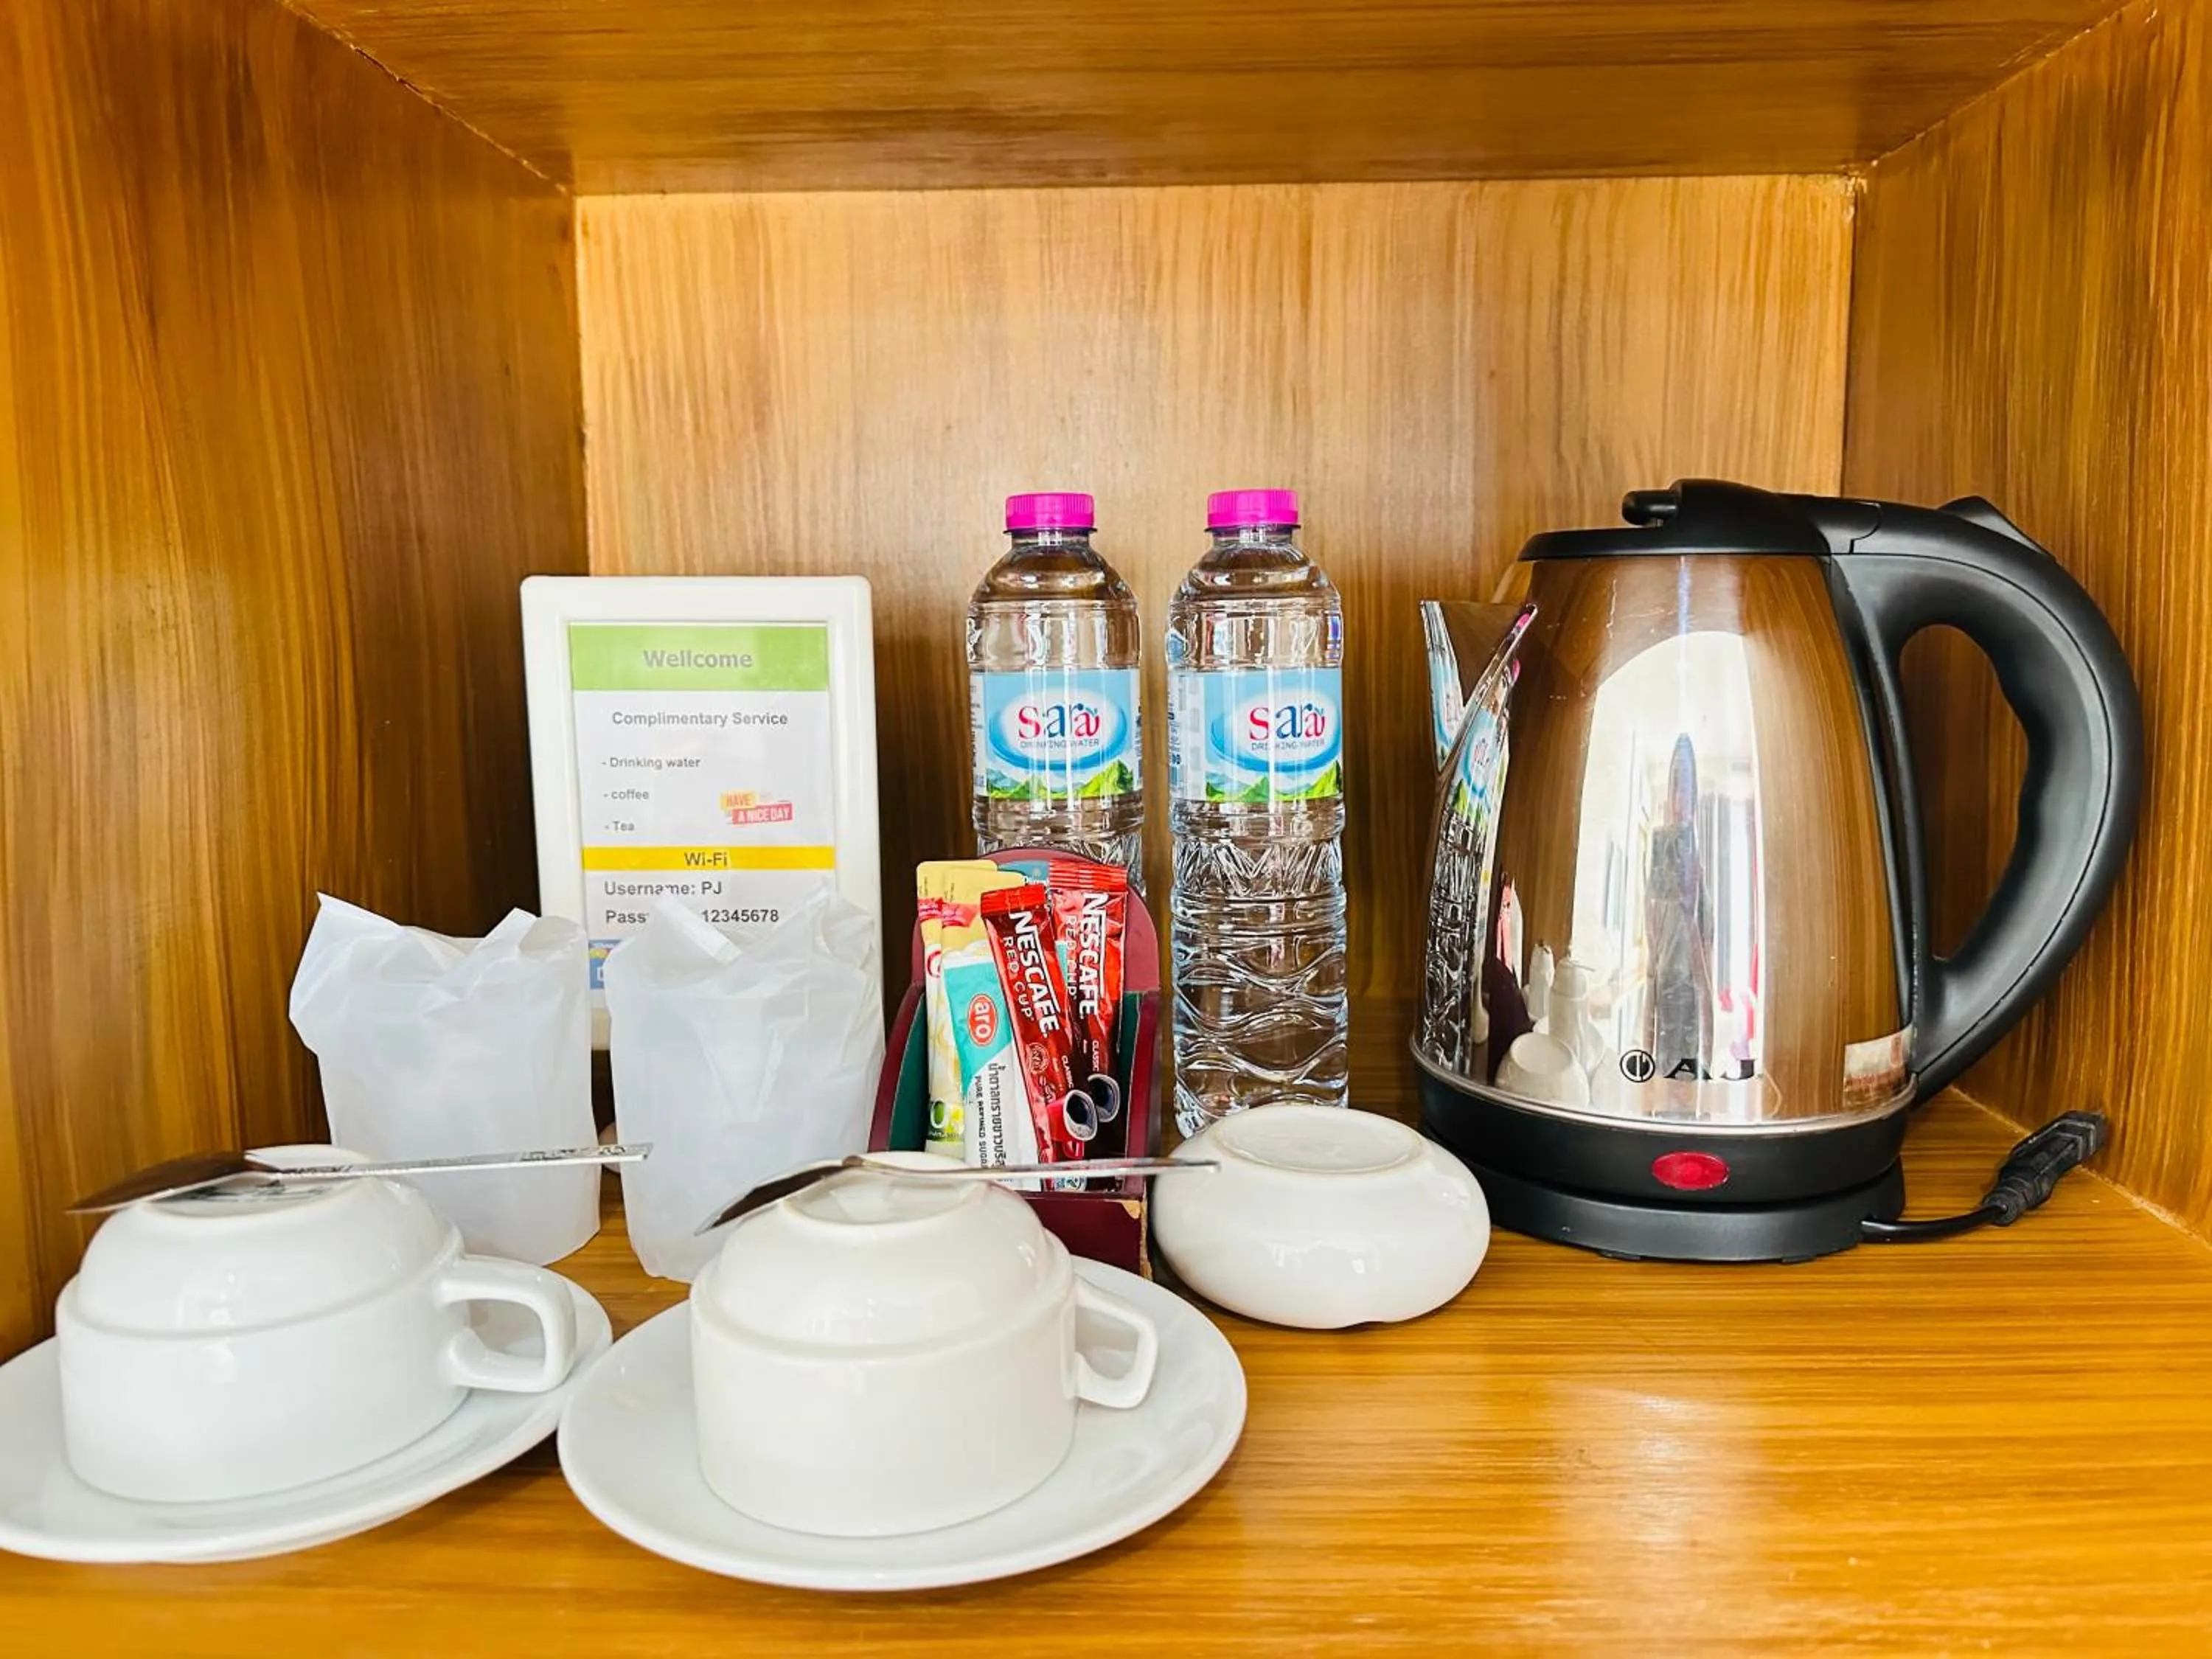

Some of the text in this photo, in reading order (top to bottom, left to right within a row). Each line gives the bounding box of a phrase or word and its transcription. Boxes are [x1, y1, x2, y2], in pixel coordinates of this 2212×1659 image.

[643, 650, 753, 668] Wellcome
[612, 712, 788, 728] Complimentary Service
[1251, 740, 1298, 751] DRIKING
[610, 757, 663, 771] Drinking
[666, 758, 700, 768] water
[611, 788, 650, 800] coffee
[613, 821, 635, 831] Tea
[684, 852, 728, 867] Wi-Fi
[701, 881, 723, 894] PJ
[701, 909, 779, 922] 12345678
[1003, 936, 1032, 1018] RED CUP
[975, 1001, 992, 1039] aro
